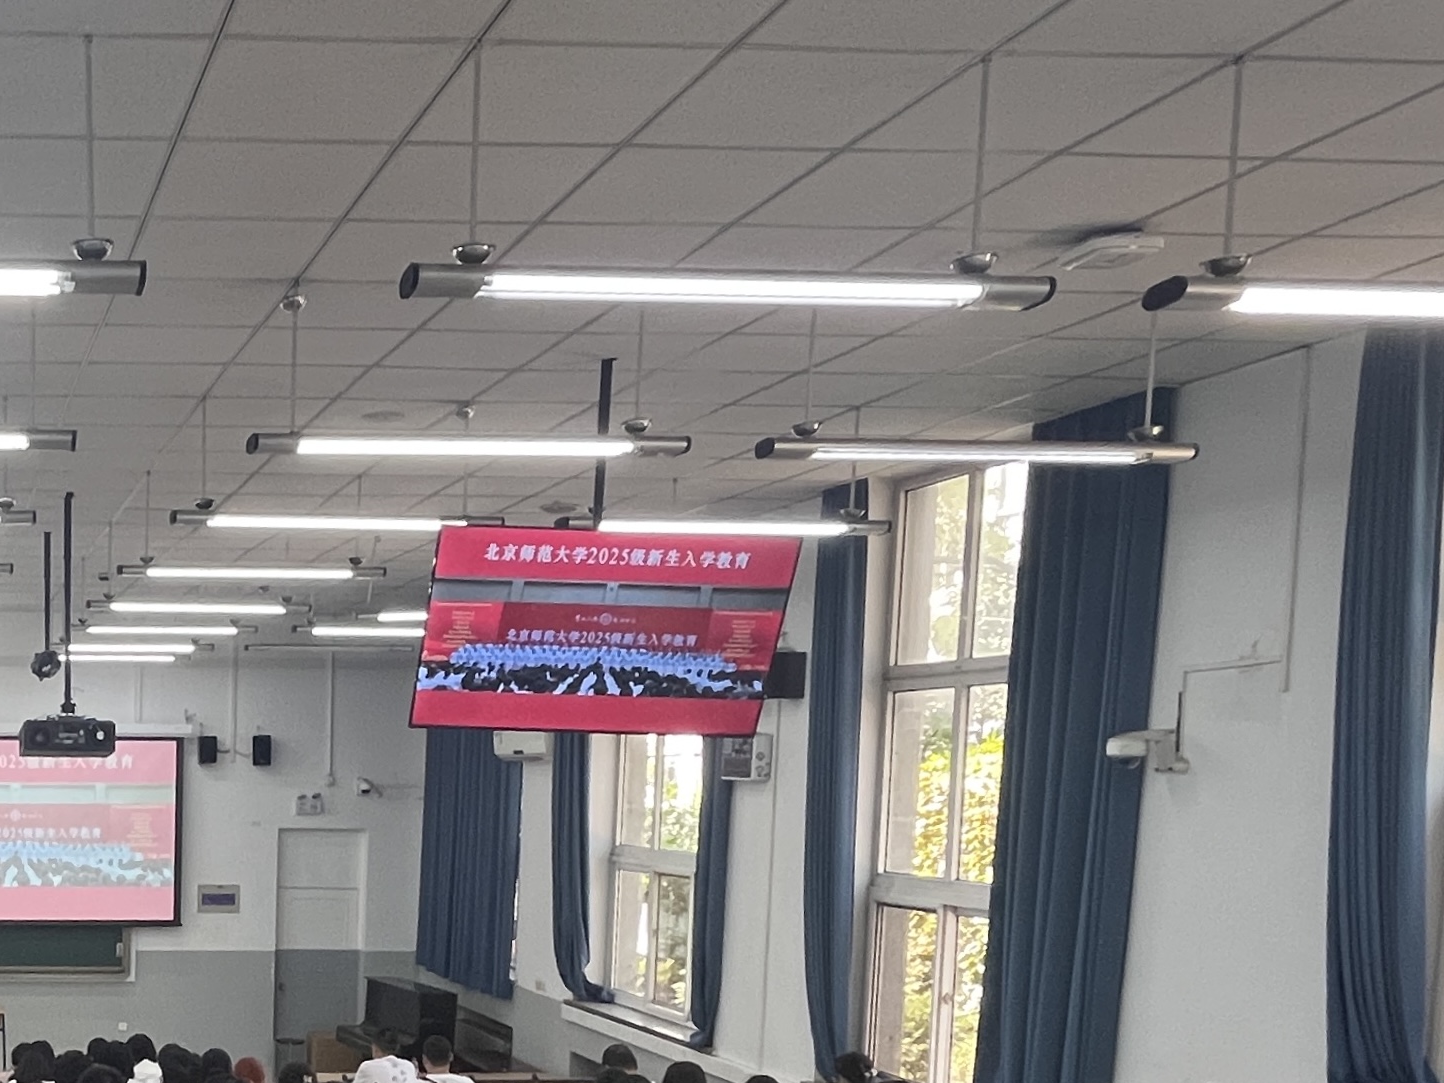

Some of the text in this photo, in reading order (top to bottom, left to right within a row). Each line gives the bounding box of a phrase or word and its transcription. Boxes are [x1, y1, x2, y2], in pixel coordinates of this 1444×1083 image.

[484, 543, 751, 570] 北京师范大学2025级新生入学教育
